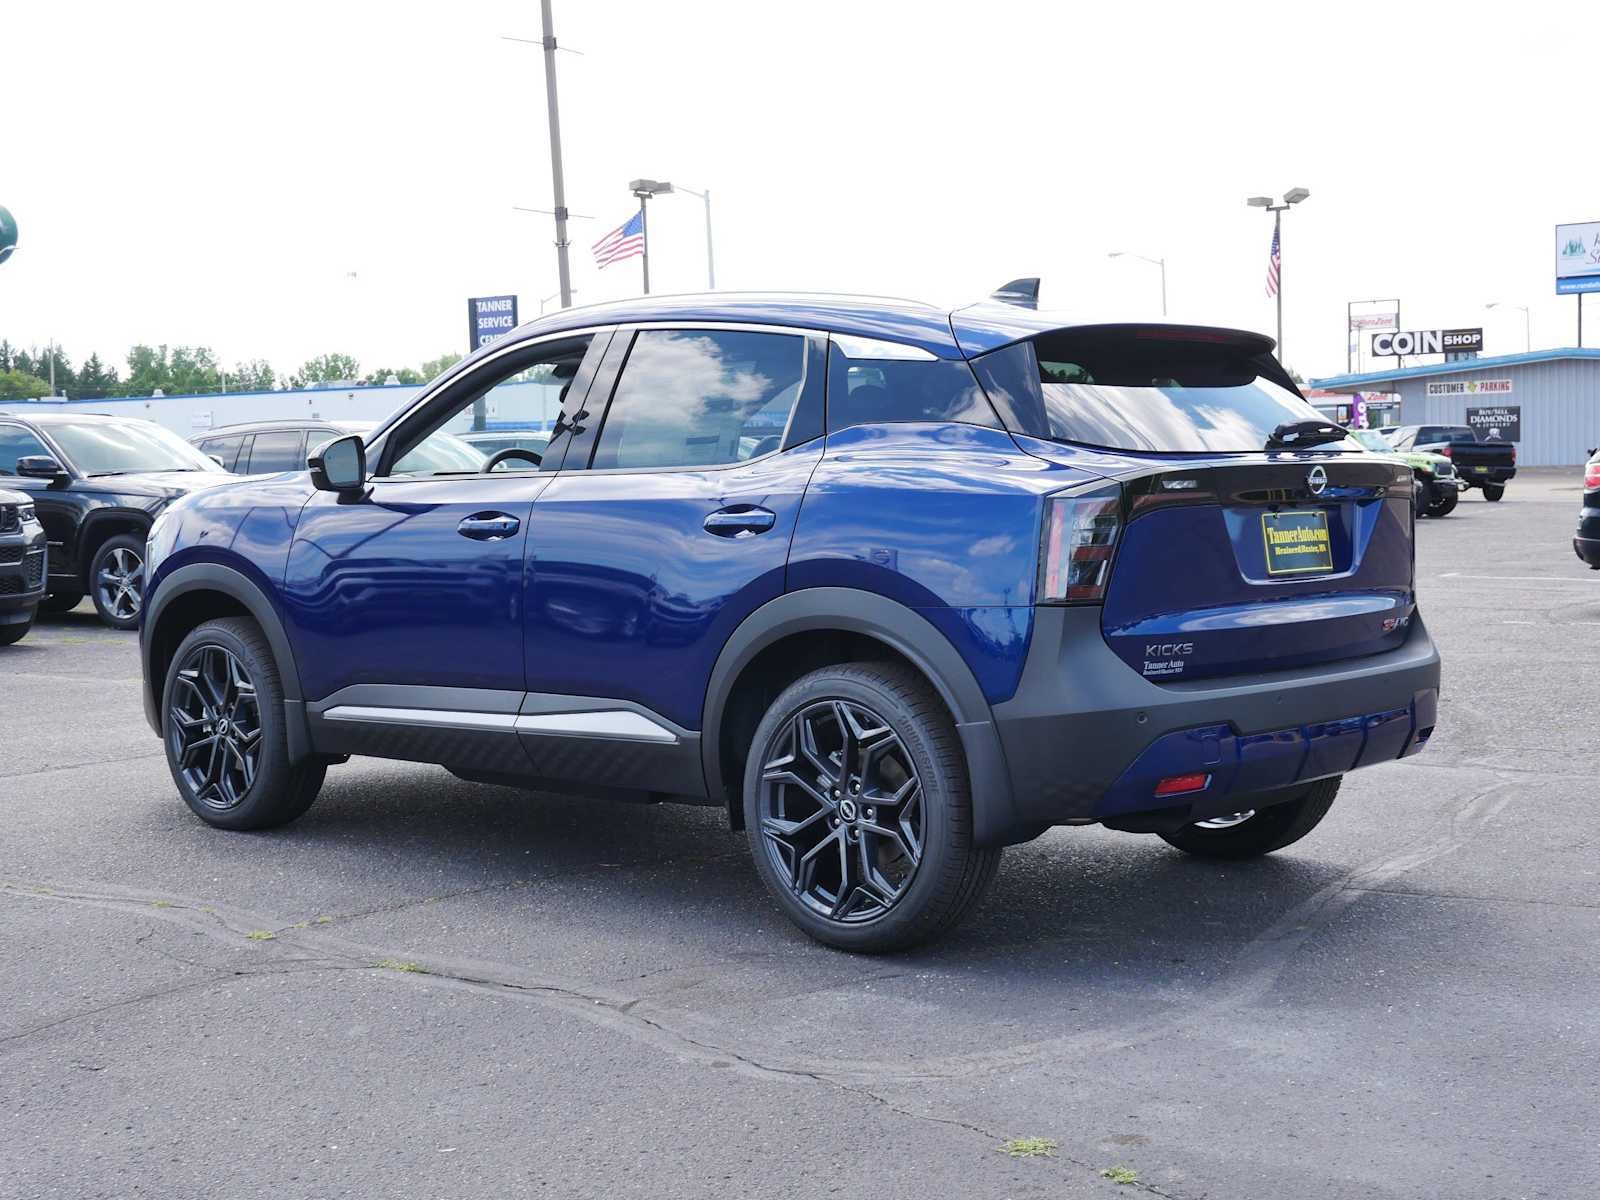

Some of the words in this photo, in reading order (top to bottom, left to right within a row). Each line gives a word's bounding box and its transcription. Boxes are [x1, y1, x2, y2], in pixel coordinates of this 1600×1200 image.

[476, 300, 512, 312] TANNER
[479, 316, 513, 328] SERVICE
[1373, 330, 1443, 355] COIN
[1444, 334, 1481, 345] SHOP
[1429, 383, 1464, 393] CUSTOMER
[1480, 381, 1510, 391] PARKING
[1470, 414, 1518, 424] DIAMONDS
[1145, 642, 1193, 656] KICKS
[1143, 661, 1168, 670] Tanner
[1168, 659, 1184, 668] Auto
